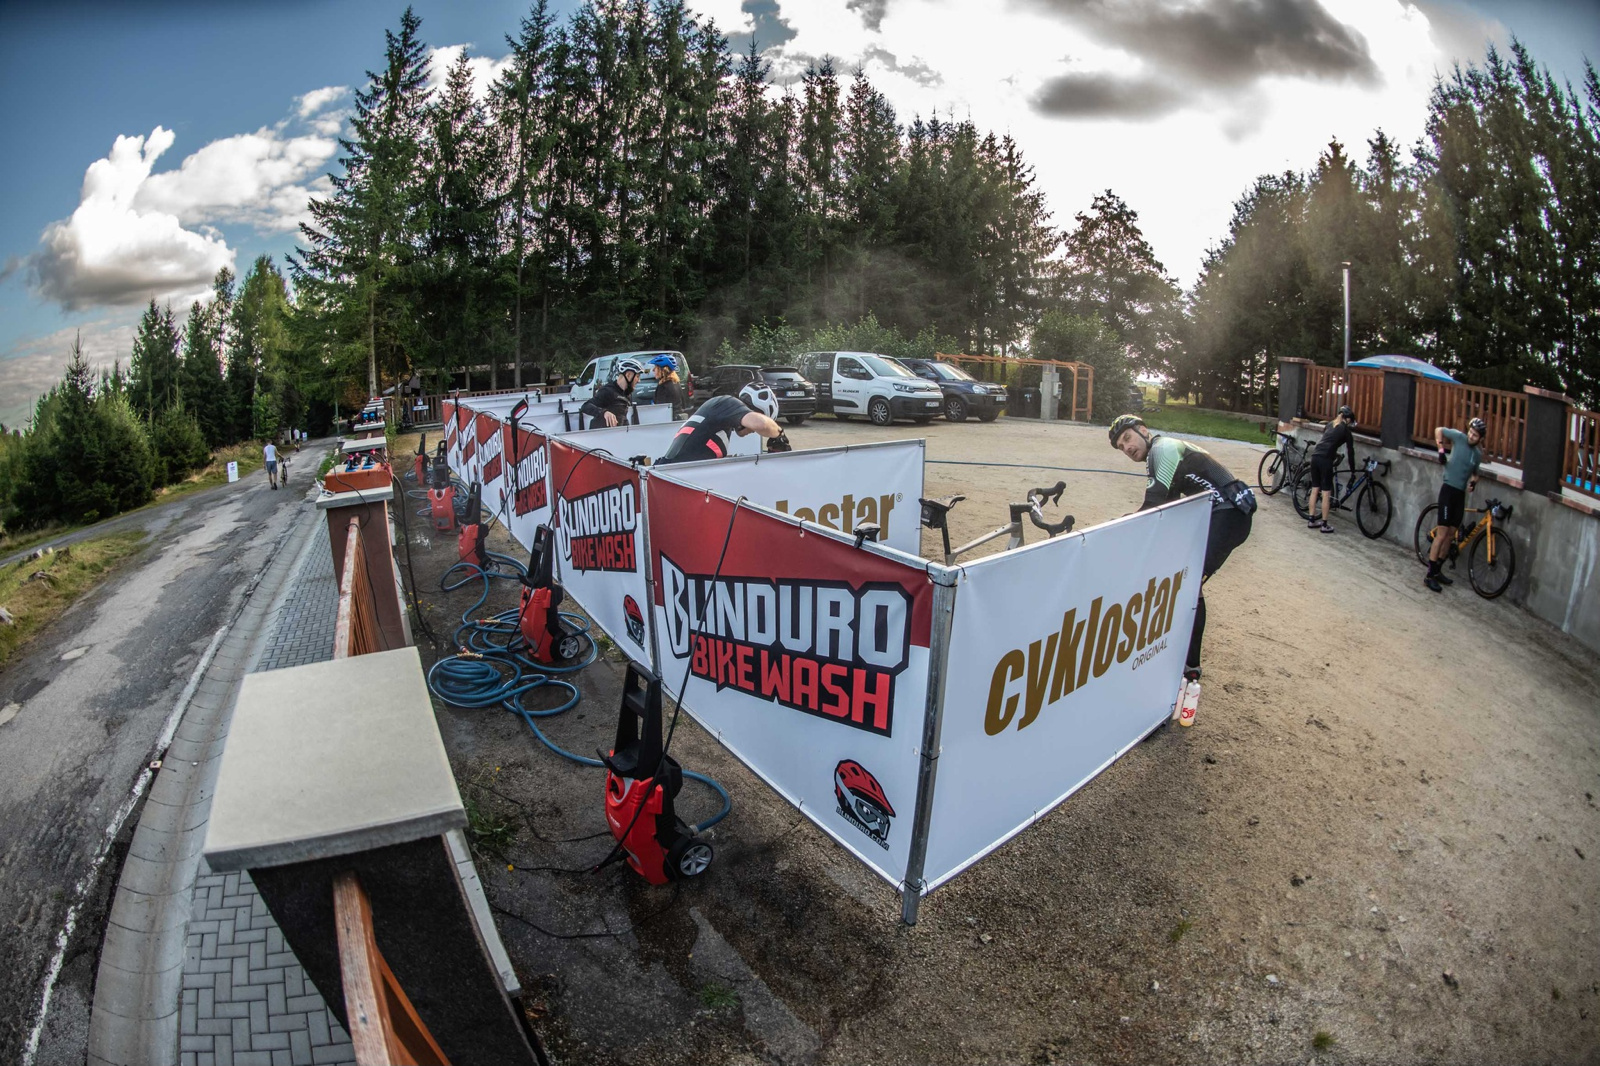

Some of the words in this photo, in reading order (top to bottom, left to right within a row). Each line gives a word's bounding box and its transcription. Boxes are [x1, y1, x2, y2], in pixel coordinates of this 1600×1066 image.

[507, 445, 546, 511] BNDURO
[558, 483, 636, 560] BLINDURO
[571, 537, 596, 571] BIKE
[595, 533, 636, 569] WASH
[661, 555, 908, 669] BLINDURO
[691, 633, 755, 692] BIKE
[761, 649, 891, 730] WASH
[984, 569, 1185, 736] cyklostar
[1132, 638, 1168, 671] ORIGINAL
[836, 806, 890, 852] BLINDURO.COM
